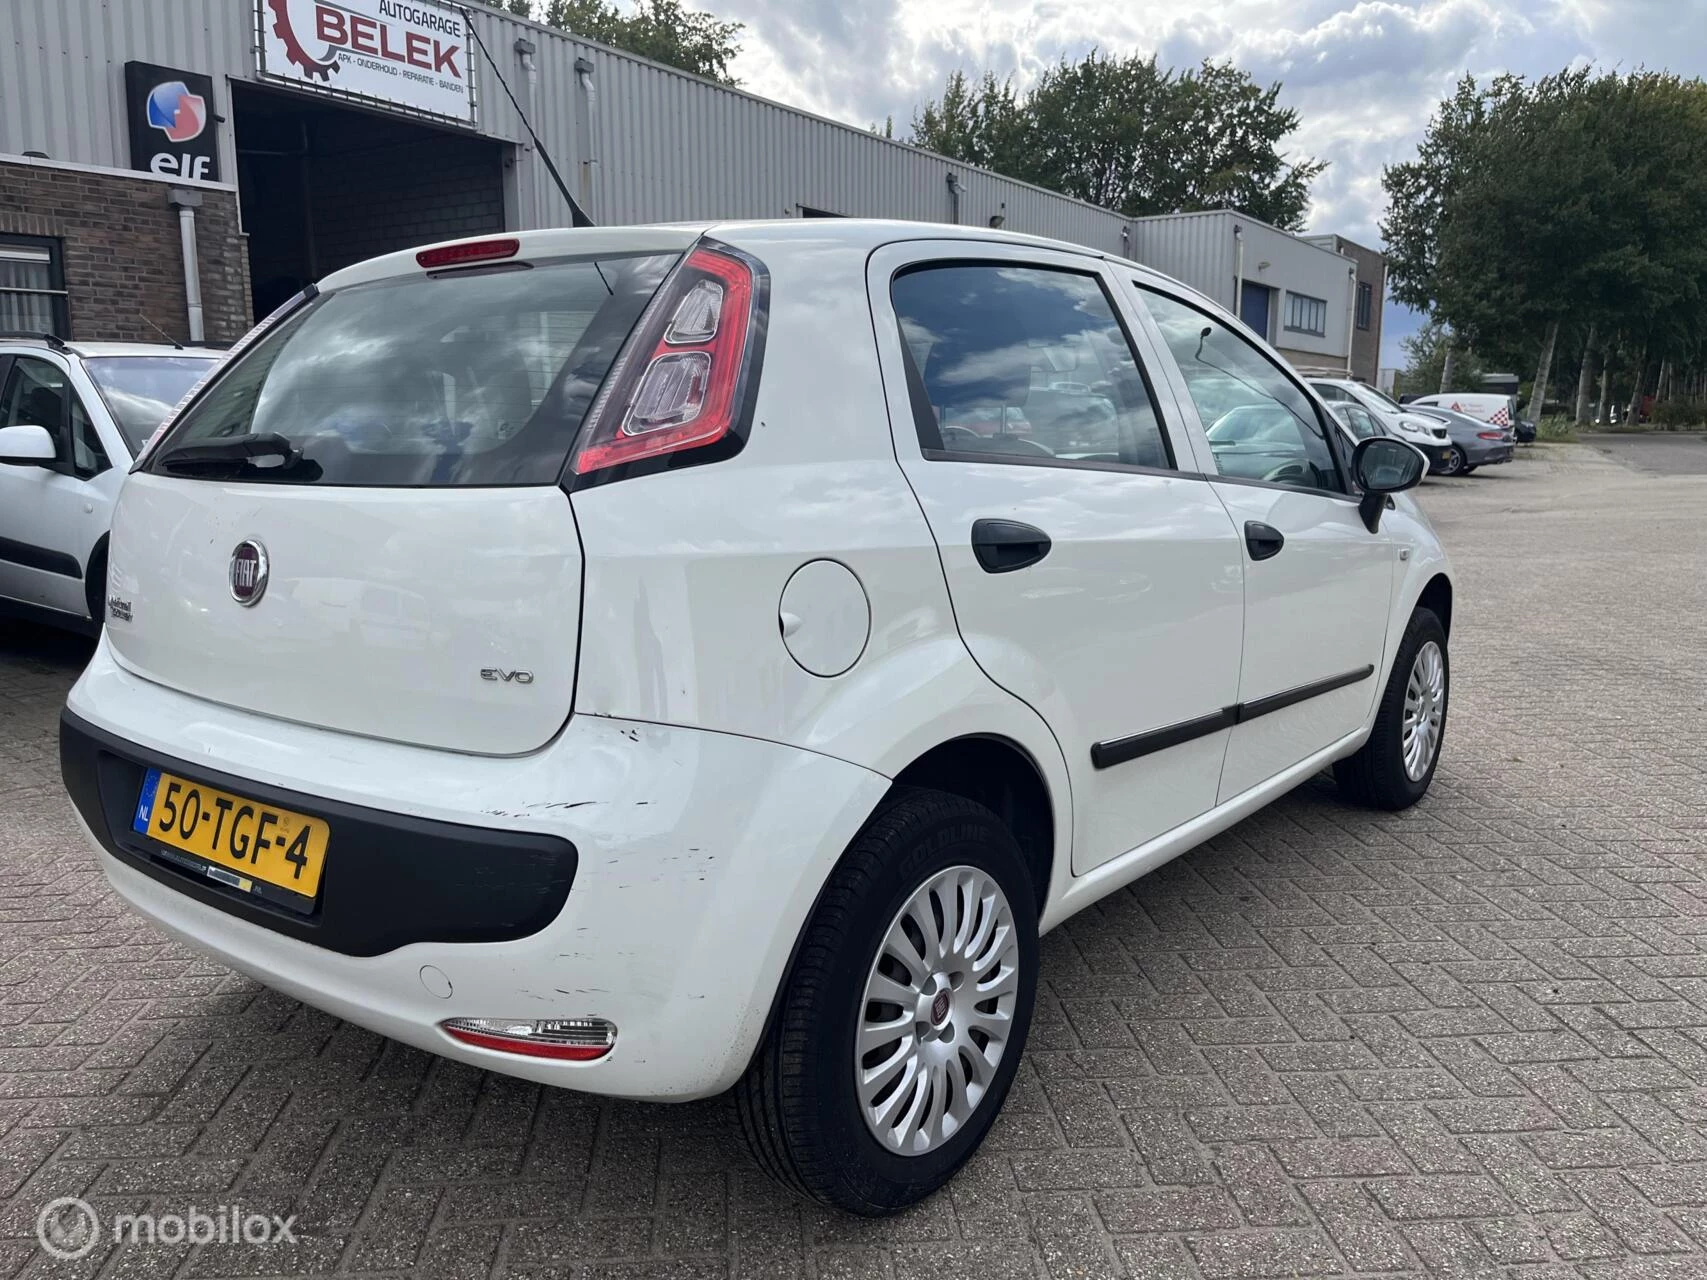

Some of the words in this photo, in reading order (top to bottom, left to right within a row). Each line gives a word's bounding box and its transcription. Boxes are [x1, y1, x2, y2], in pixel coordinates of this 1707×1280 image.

[379, 0, 461, 38] AUTOGARAGE
[315, 4, 462, 79] BELEK
[338, 52, 352, 65] APK
[356, 58, 398, 77] ONDERHOUD
[402, 69, 435, 87] REPARATIE
[438, 79, 464, 94] BANDEN
[150, 152, 211, 182] elf
[235, 559, 257, 588] FIAT
[480, 667, 534, 684] EVO
[138, 805, 148, 822] NL
[159, 782, 312, 880] 50-TGF-4
